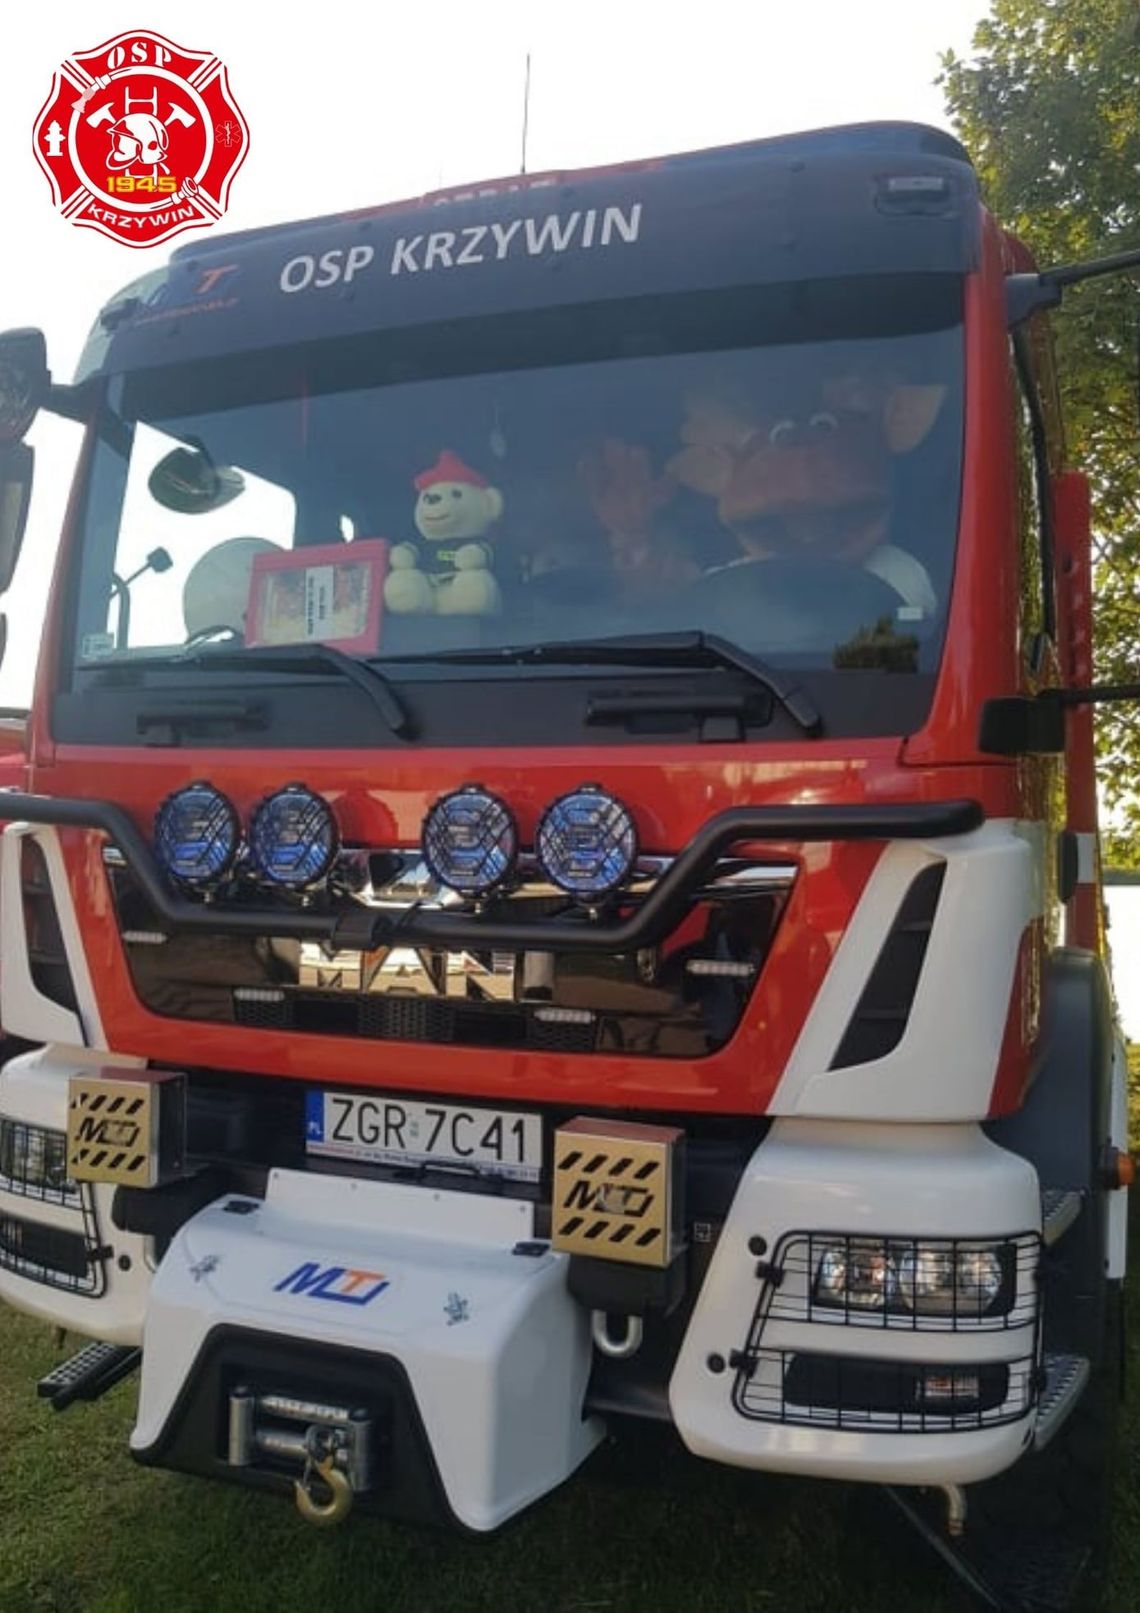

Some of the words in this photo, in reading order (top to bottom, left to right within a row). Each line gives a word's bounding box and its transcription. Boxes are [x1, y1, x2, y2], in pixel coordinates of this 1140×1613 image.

[280, 245, 374, 294] OSP
[390, 204, 642, 276] KRZYWIN
[332, 1098, 407, 1149] ZGR
[425, 1109, 525, 1163] 7C41
